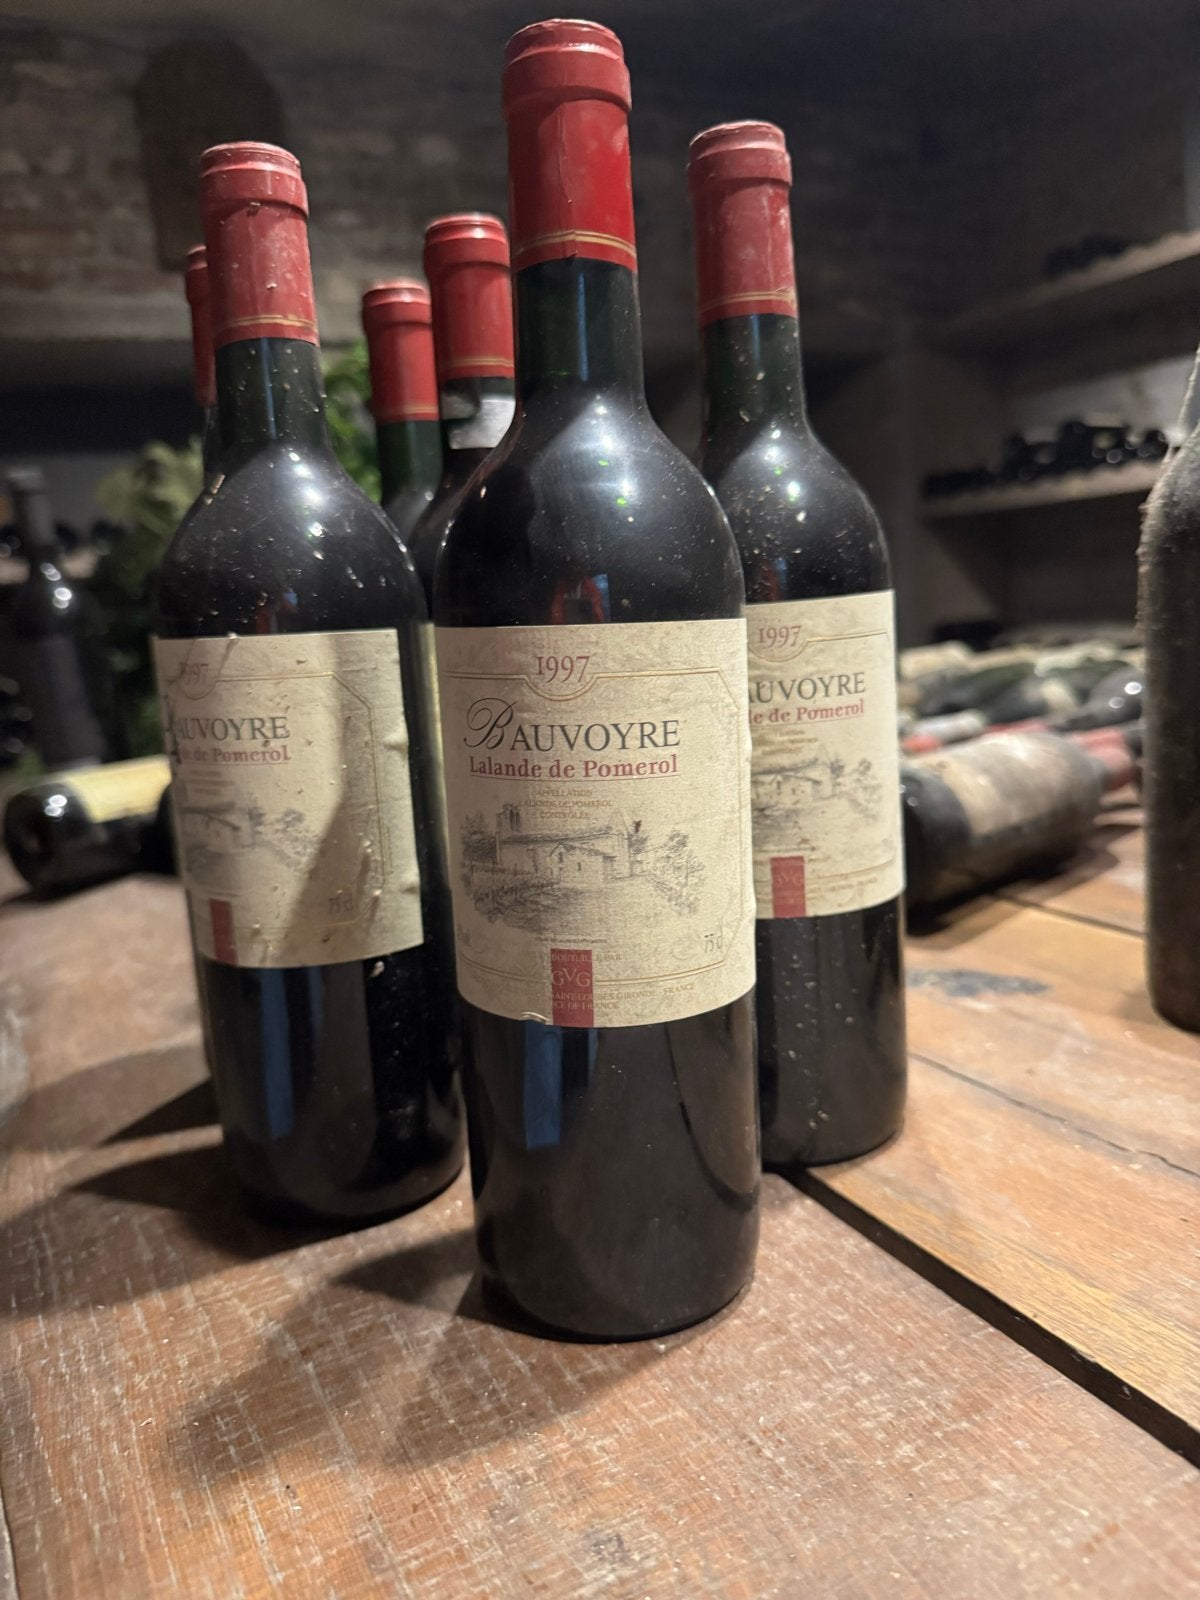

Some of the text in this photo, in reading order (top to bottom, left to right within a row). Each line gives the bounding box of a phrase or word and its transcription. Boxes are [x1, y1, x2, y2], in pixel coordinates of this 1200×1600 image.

[757, 625, 802, 649] 1997
[535, 655, 591, 684] 1997
[768, 708, 791, 724] de
[796, 699, 865, 722] Pomerol
[463, 696, 681, 753] BAUVOYRE
[211, 744, 292, 763] Pomerol
[469, 753, 679, 779] Lalande de Pomerol
[551, 967, 591, 988] GVG
